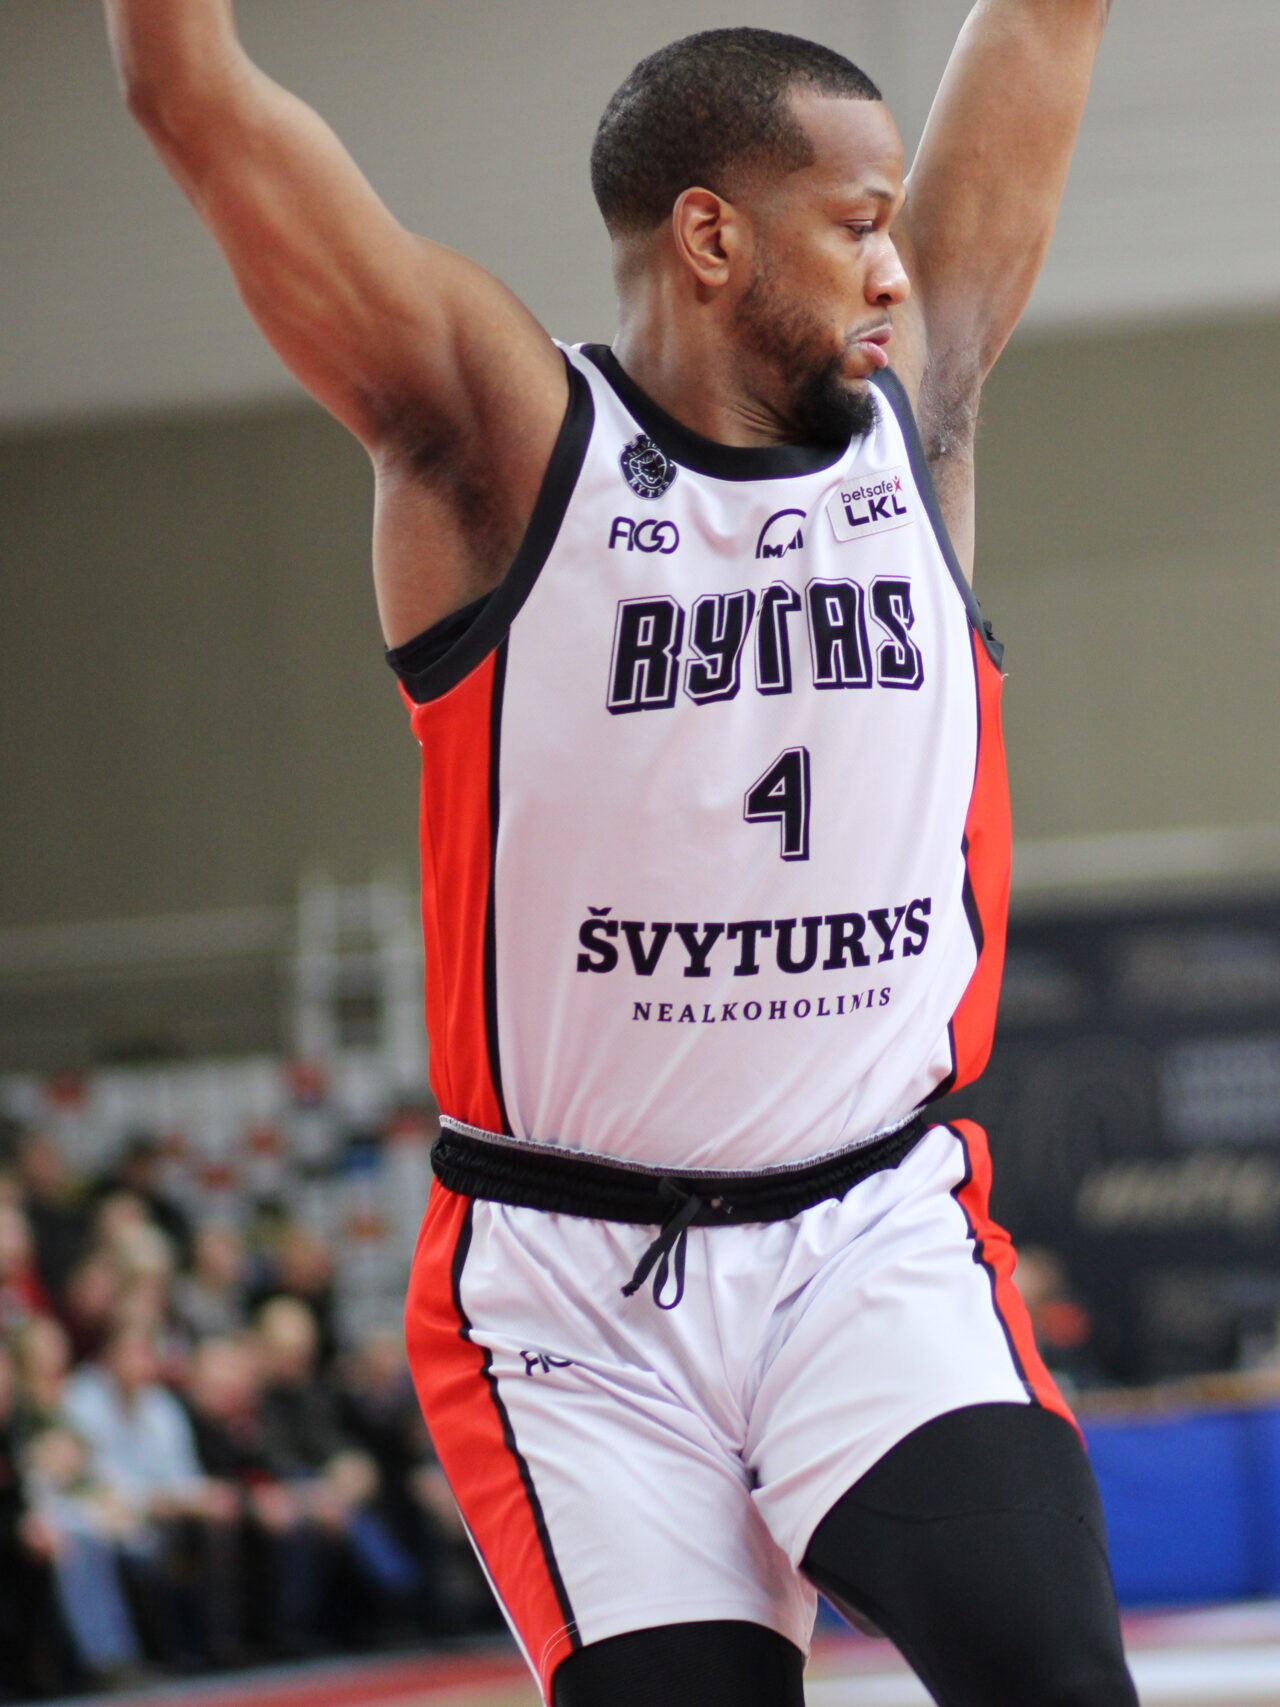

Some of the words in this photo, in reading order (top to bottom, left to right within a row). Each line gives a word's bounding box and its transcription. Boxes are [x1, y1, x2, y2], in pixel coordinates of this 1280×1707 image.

[841, 481, 894, 504] betsafe
[844, 494, 907, 527] LKL
[606, 574, 925, 715] RYTAS
[743, 745, 811, 862] 4
[577, 897, 932, 978] ŠVYTURYS
[632, 986, 892, 1023] NEALKOHOLINIS
